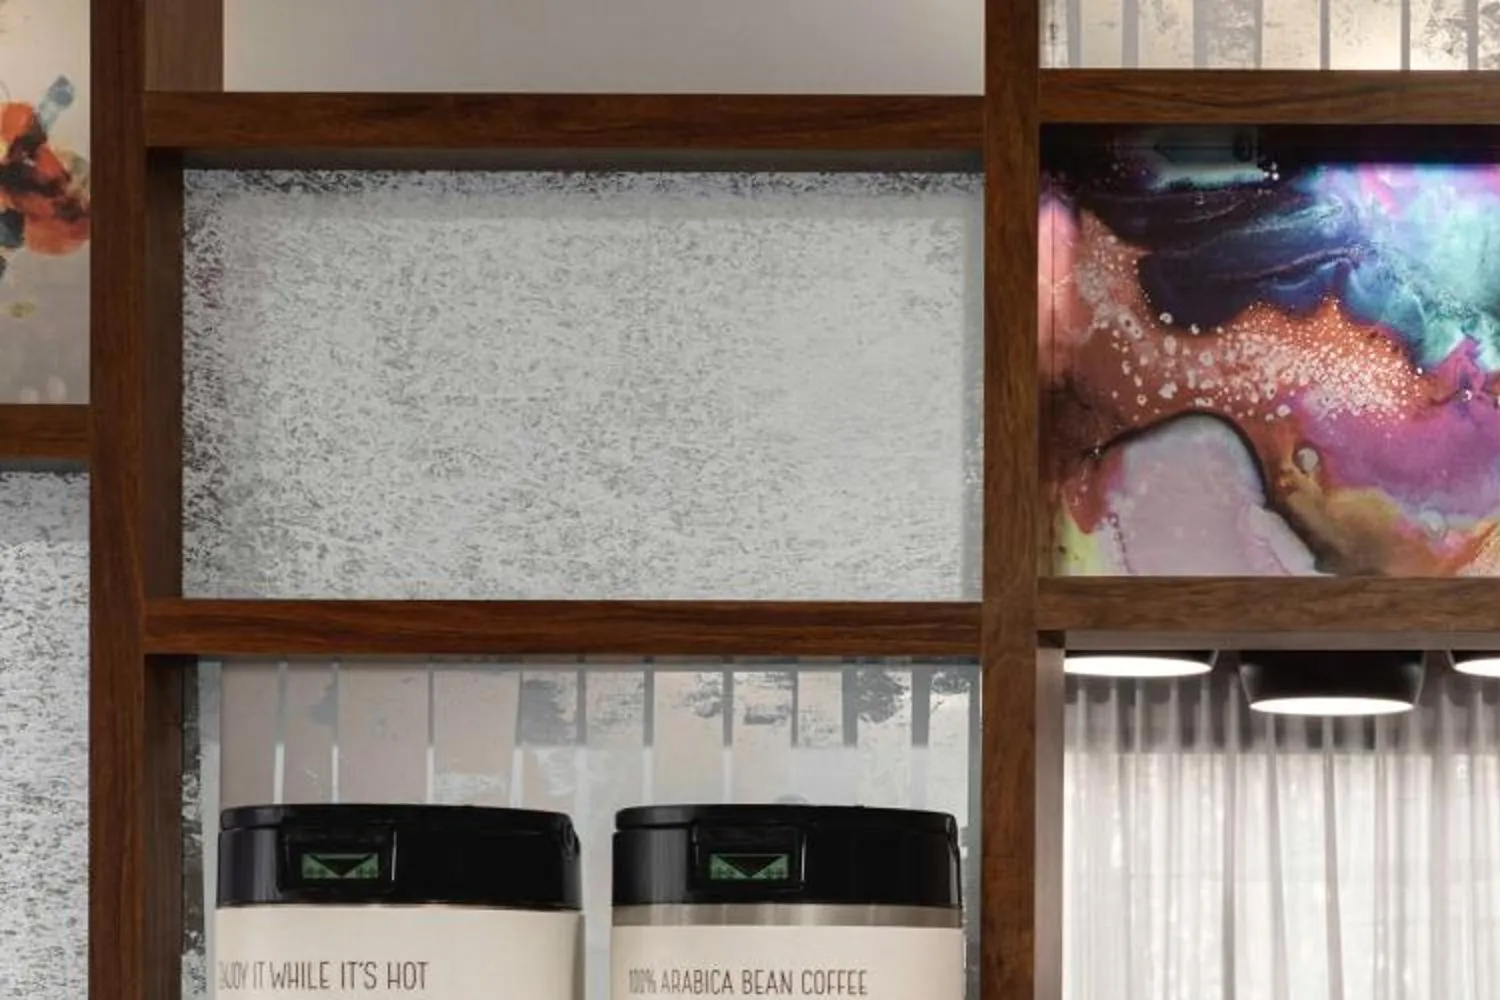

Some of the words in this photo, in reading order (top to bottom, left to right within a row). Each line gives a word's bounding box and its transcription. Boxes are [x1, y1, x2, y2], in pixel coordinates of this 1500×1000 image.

[253, 961, 265, 990] IT
[270, 961, 330, 990] WHILE
[341, 961, 377, 990] IT'S
[387, 961, 429, 990] HOT
[660, 969, 733, 995] ARABICA
[742, 970, 793, 995] BEAN
[801, 970, 868, 996] COFFEE
